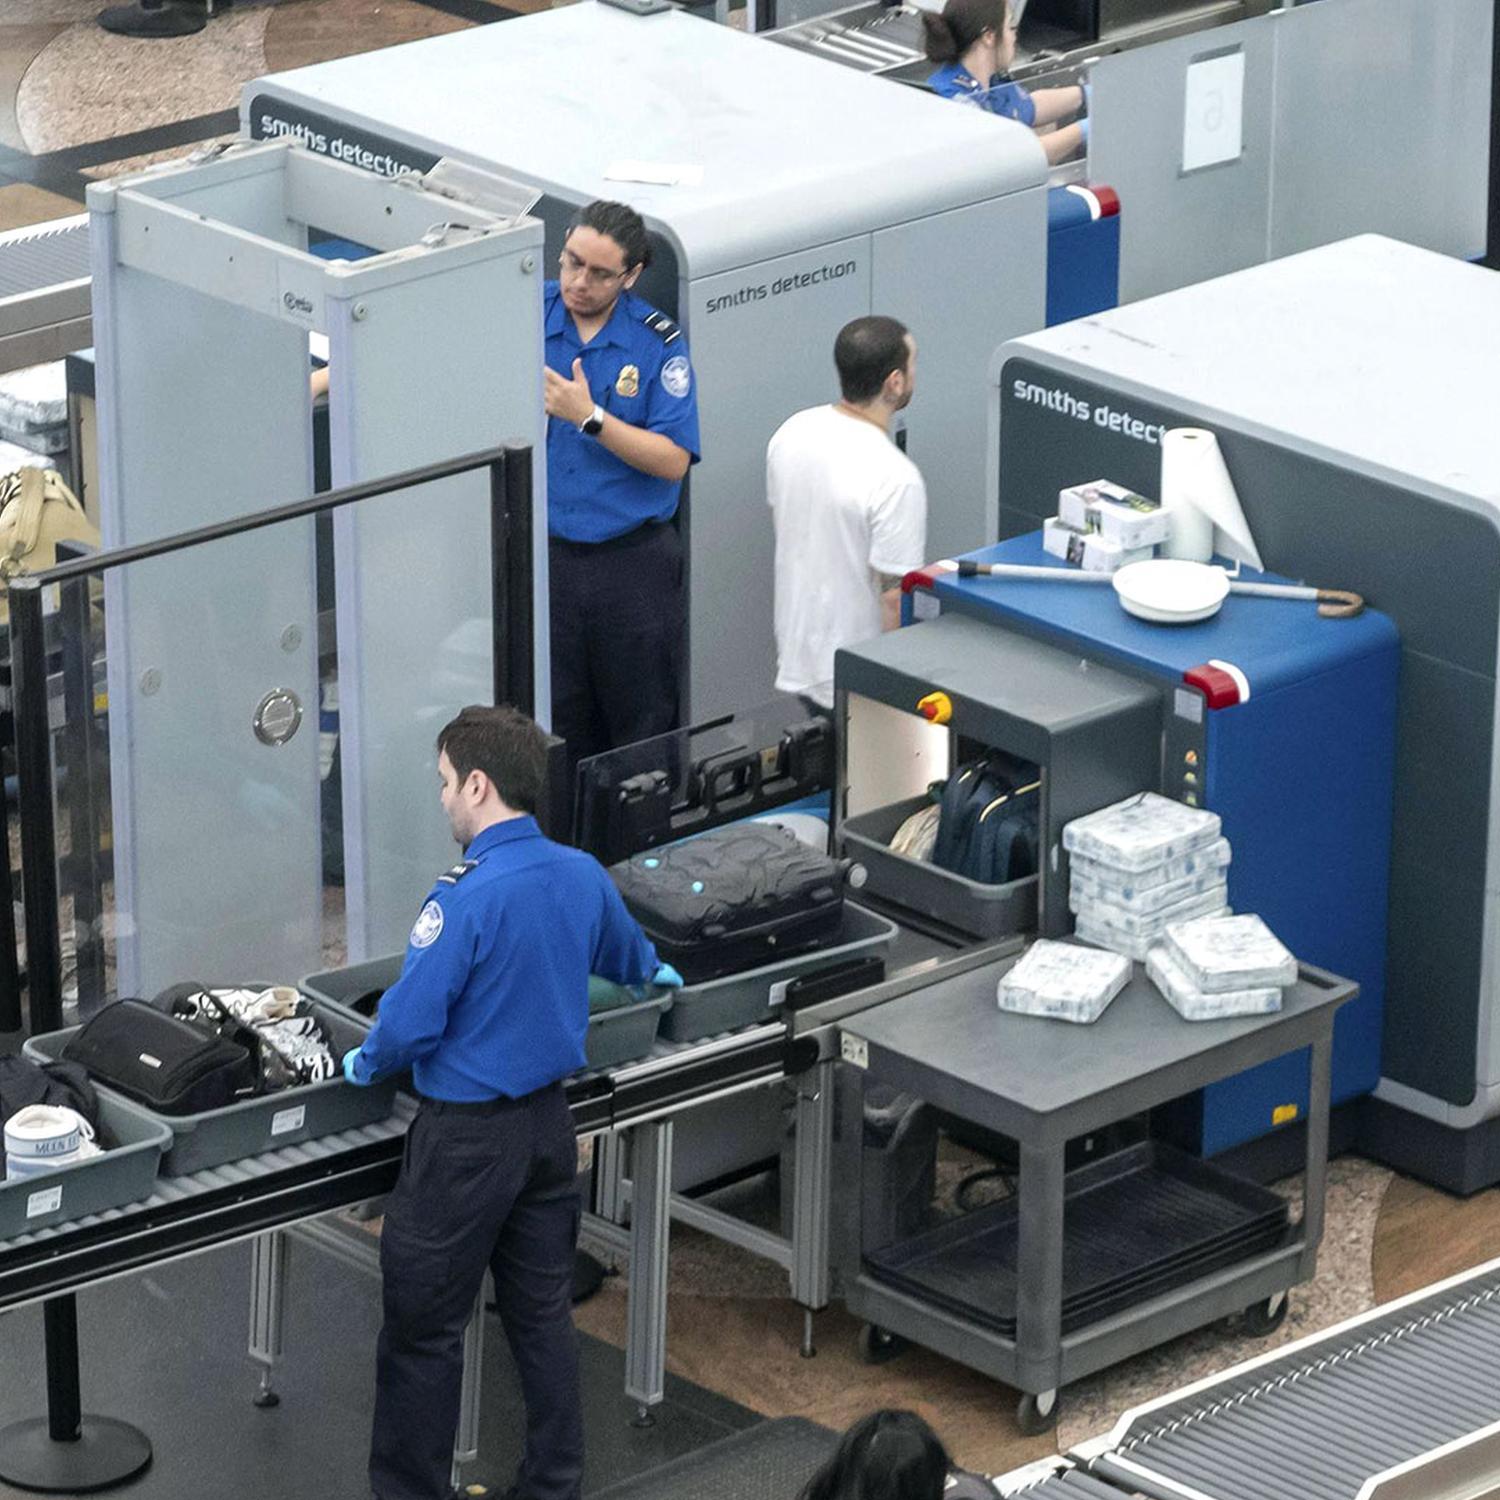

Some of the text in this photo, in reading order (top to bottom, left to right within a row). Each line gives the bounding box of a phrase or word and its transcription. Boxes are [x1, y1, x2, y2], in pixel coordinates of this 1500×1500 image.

[706, 260, 857, 314] smiths detection
[1013, 379, 1167, 444] smiths detect
